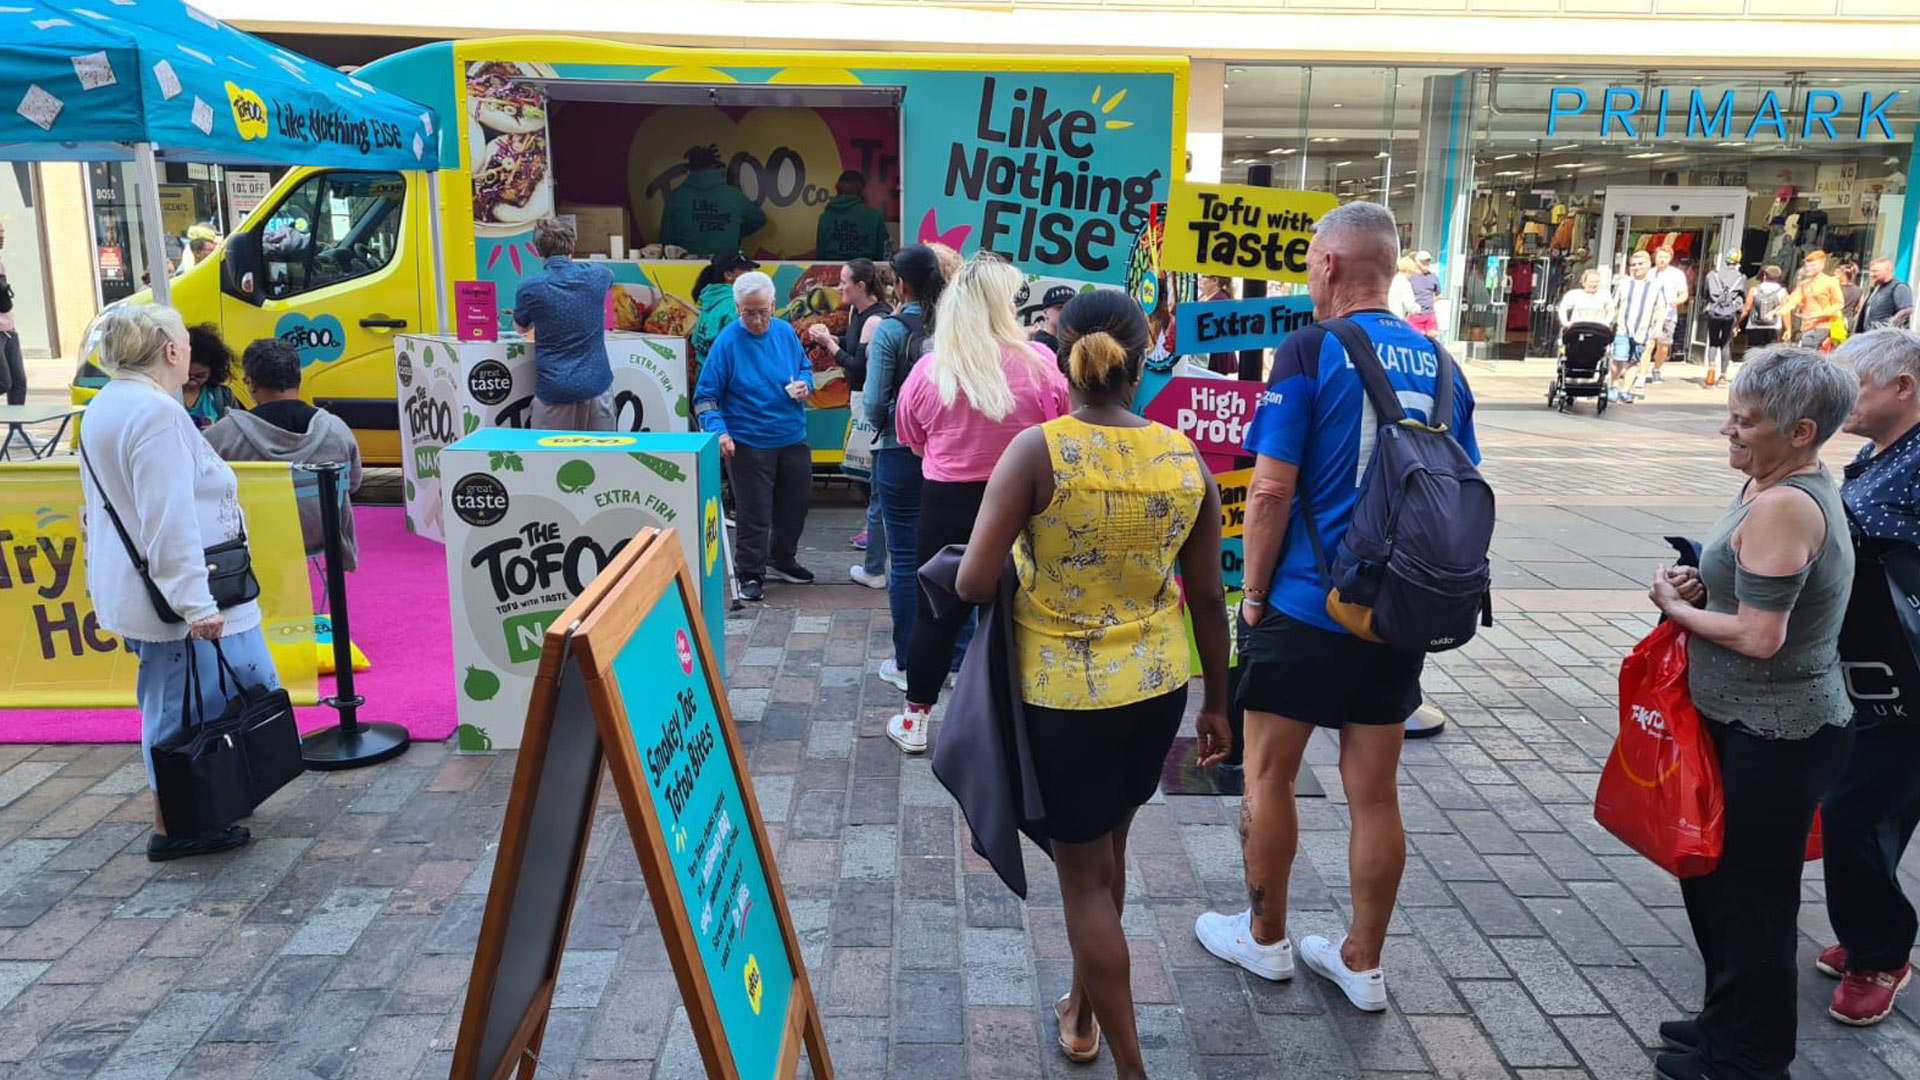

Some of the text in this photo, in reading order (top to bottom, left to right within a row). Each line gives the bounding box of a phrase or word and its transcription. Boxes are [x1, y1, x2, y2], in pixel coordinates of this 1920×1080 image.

[272, 98, 402, 154] Like Nothing Else
[976, 76, 1096, 158] Like
[1547, 87, 1900, 139] PRIMARK
[96, 188, 116, 200] BOSS
[944, 142, 1161, 234] Nothing
[1197, 192, 1315, 232] Tofu with
[980, 200, 1116, 272] Else
[1189, 221, 1309, 273] Taste
[1196, 311, 1266, 342] Extra
[471, 375, 511, 391] taste
[479, 368, 501, 380] great
[629, 353, 675, 394] EXTRA FIRM
[1191, 387, 1246, 419] High
[456, 493, 506, 509] taste
[466, 484, 493, 496] great
[594, 489, 677, 523] EXTRA FIRM
[519, 521, 561, 547] THE
[495, 602, 519, 615] TOFU
[540, 592, 568, 604] TASTE
[647, 708, 684, 788] Smokey
[676, 686, 698, 730] Joe
[664, 721, 714, 824] Tofoo Bites
